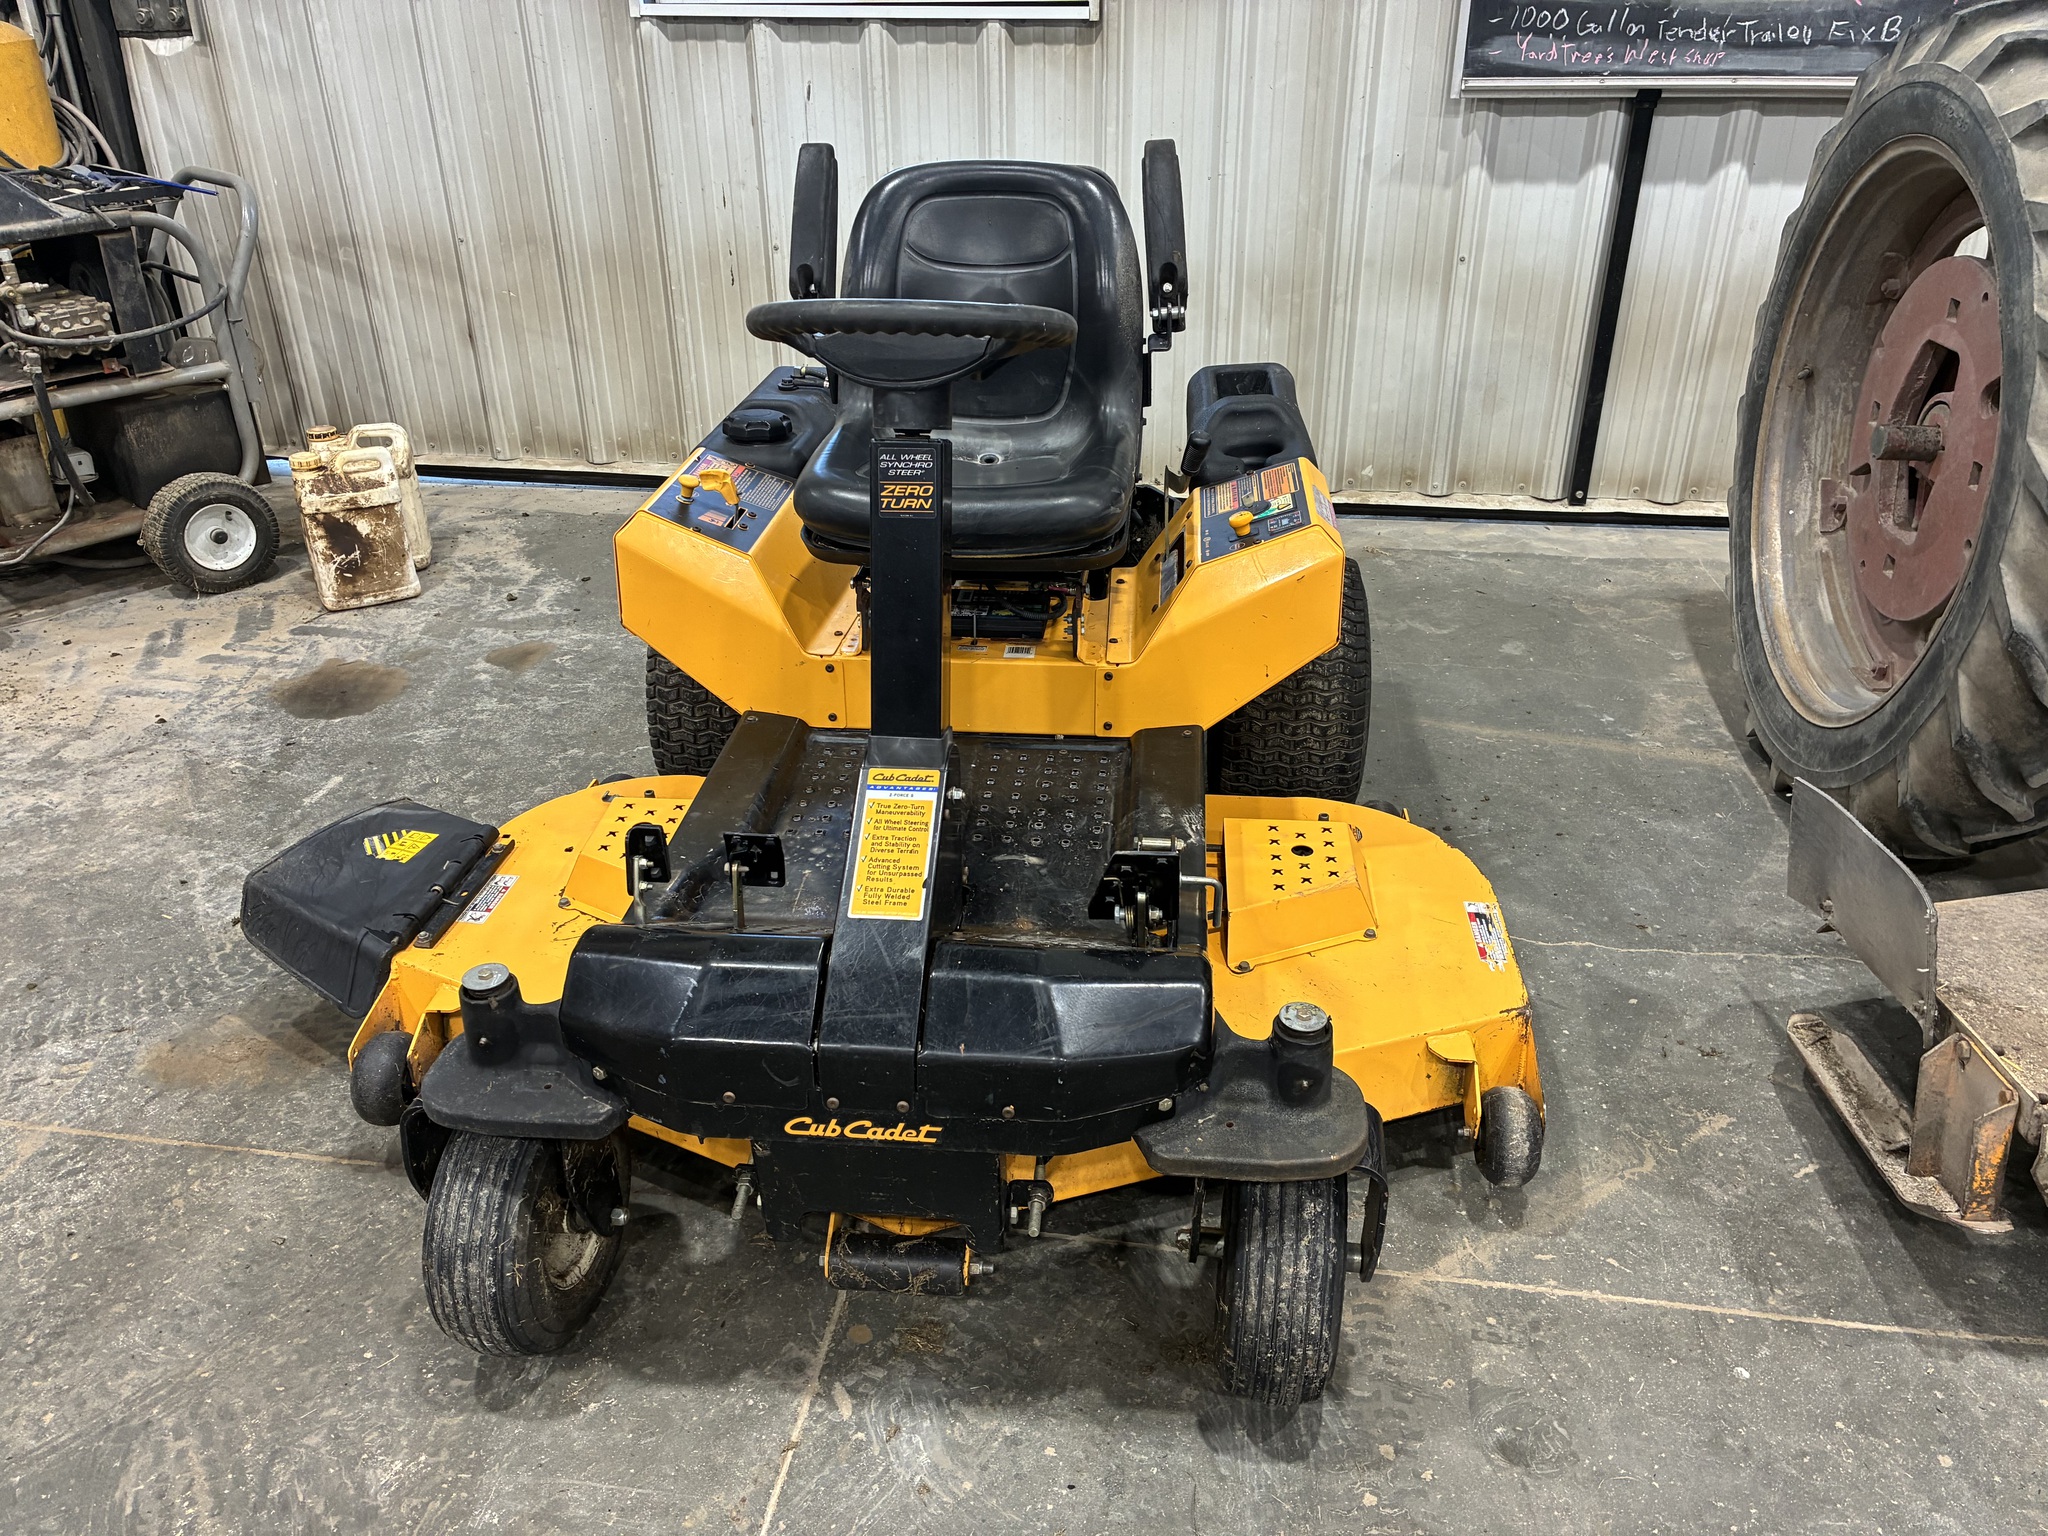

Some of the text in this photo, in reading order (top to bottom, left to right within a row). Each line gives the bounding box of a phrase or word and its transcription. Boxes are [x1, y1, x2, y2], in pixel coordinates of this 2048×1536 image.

[1577, 7, 1645, 36] Gallon
[880, 453, 933, 461] ALL WHEEL
[880, 461, 933, 469] SYNCHRO
[880, 485, 934, 497] ZERO
[881, 498, 933, 509] TURN
[873, 773, 895, 782] Cub
[875, 809, 927, 817] Maneuverability
[863, 892, 882, 900] Fully
[784, 1116, 943, 1143] Cub Cadet
